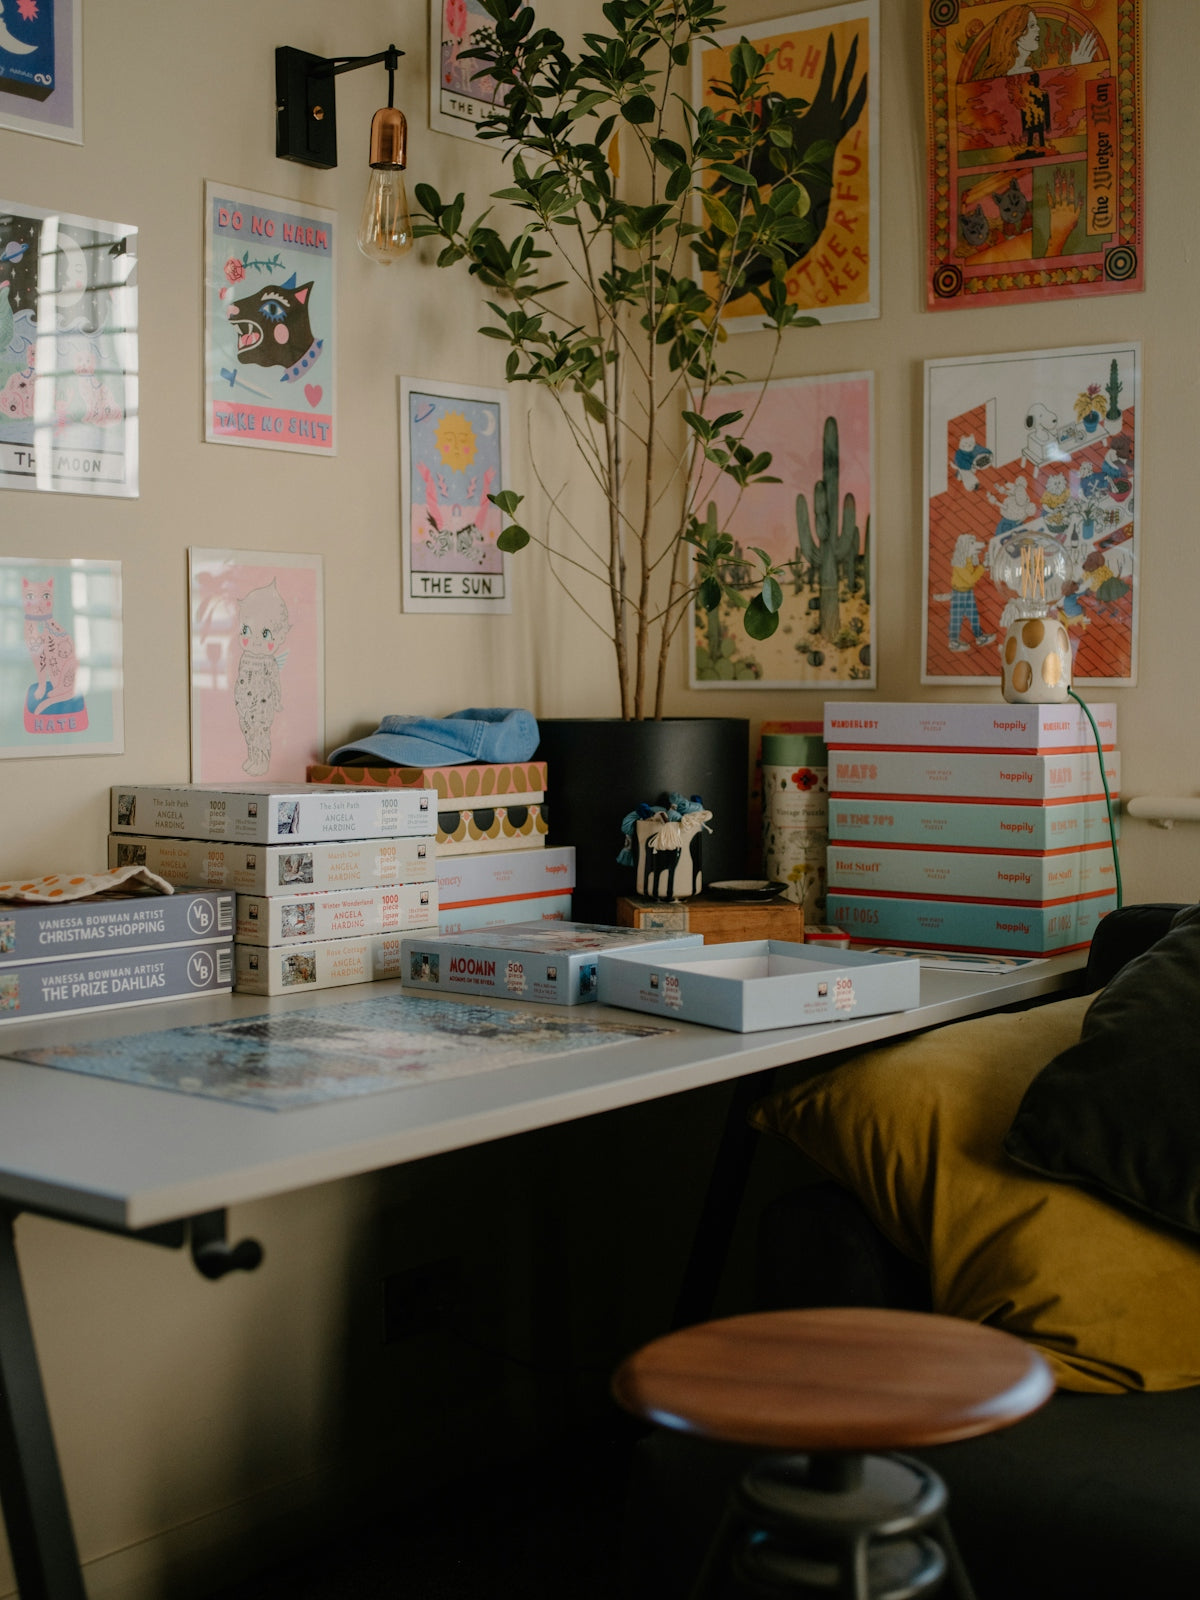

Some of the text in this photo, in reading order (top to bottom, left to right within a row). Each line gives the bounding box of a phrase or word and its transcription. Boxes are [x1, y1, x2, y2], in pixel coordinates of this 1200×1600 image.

[450, 99, 473, 115] THE
[785, 130, 862, 297] OTHERFU-
[1092, 196, 1113, 231] The
[218, 207, 328, 249] DO NO HARM
[216, 411, 330, 441] TAKE NO SHIT
[57, 456, 102, 473] MOON
[420, 577, 492, 594] THE SUN
[34, 717, 77, 731] HATE
[993, 719, 1026, 731] happily
[836, 764, 877, 780] MATS
[1000, 770, 1033, 783] happily
[210, 801, 225, 810] 1000
[320, 802, 333, 810] The
[333, 802, 346, 810] Salt
[381, 799, 398, 808] 1000
[157, 811, 183, 819] ANGELA
[325, 814, 354, 822] ANGELA
[849, 814, 870, 825] THE
[155, 821, 185, 830] HARDING
[322, 823, 356, 832] HARDING
[1000, 822, 1034, 834] happily
[208, 851, 224, 861] 1000
[380, 847, 396, 856] 1000
[161, 860, 187, 869] ANGELA
[330, 863, 359, 871] ANGELA
[545, 864, 569, 875] happily
[835, 860, 881, 872] Hot Stuff
[158, 870, 189, 879] HARDING
[328, 872, 361, 882] HARDING
[997, 871, 1031, 884] happily
[322, 899, 374, 910] Winter Wonderland
[382, 894, 399, 904] 1000
[39, 909, 165, 930] VANESSA BOWMAN ARTIST
[334, 910, 363, 919] ANGELA
[854, 908, 880, 924] DOGS
[331, 920, 365, 930] HARDING
[382, 919, 399, 928] puzzle
[996, 921, 1029, 934] happily
[39, 920, 165, 944] CHRISTMAS SHOPPING
[383, 940, 399, 950] 1000
[342, 946, 367, 956] Cottage
[333, 959, 362, 967] ANGELA
[449, 957, 496, 977] MOOMIN
[508, 963, 523, 973] 500
[41, 962, 165, 986] VANESSA BOWMAN ARTIST
[331, 968, 364, 977] HARDING
[665, 976, 679, 987] 500
[836, 979, 852, 990] 500
[41, 973, 166, 1002] THE PRIZE DAHLIAS
